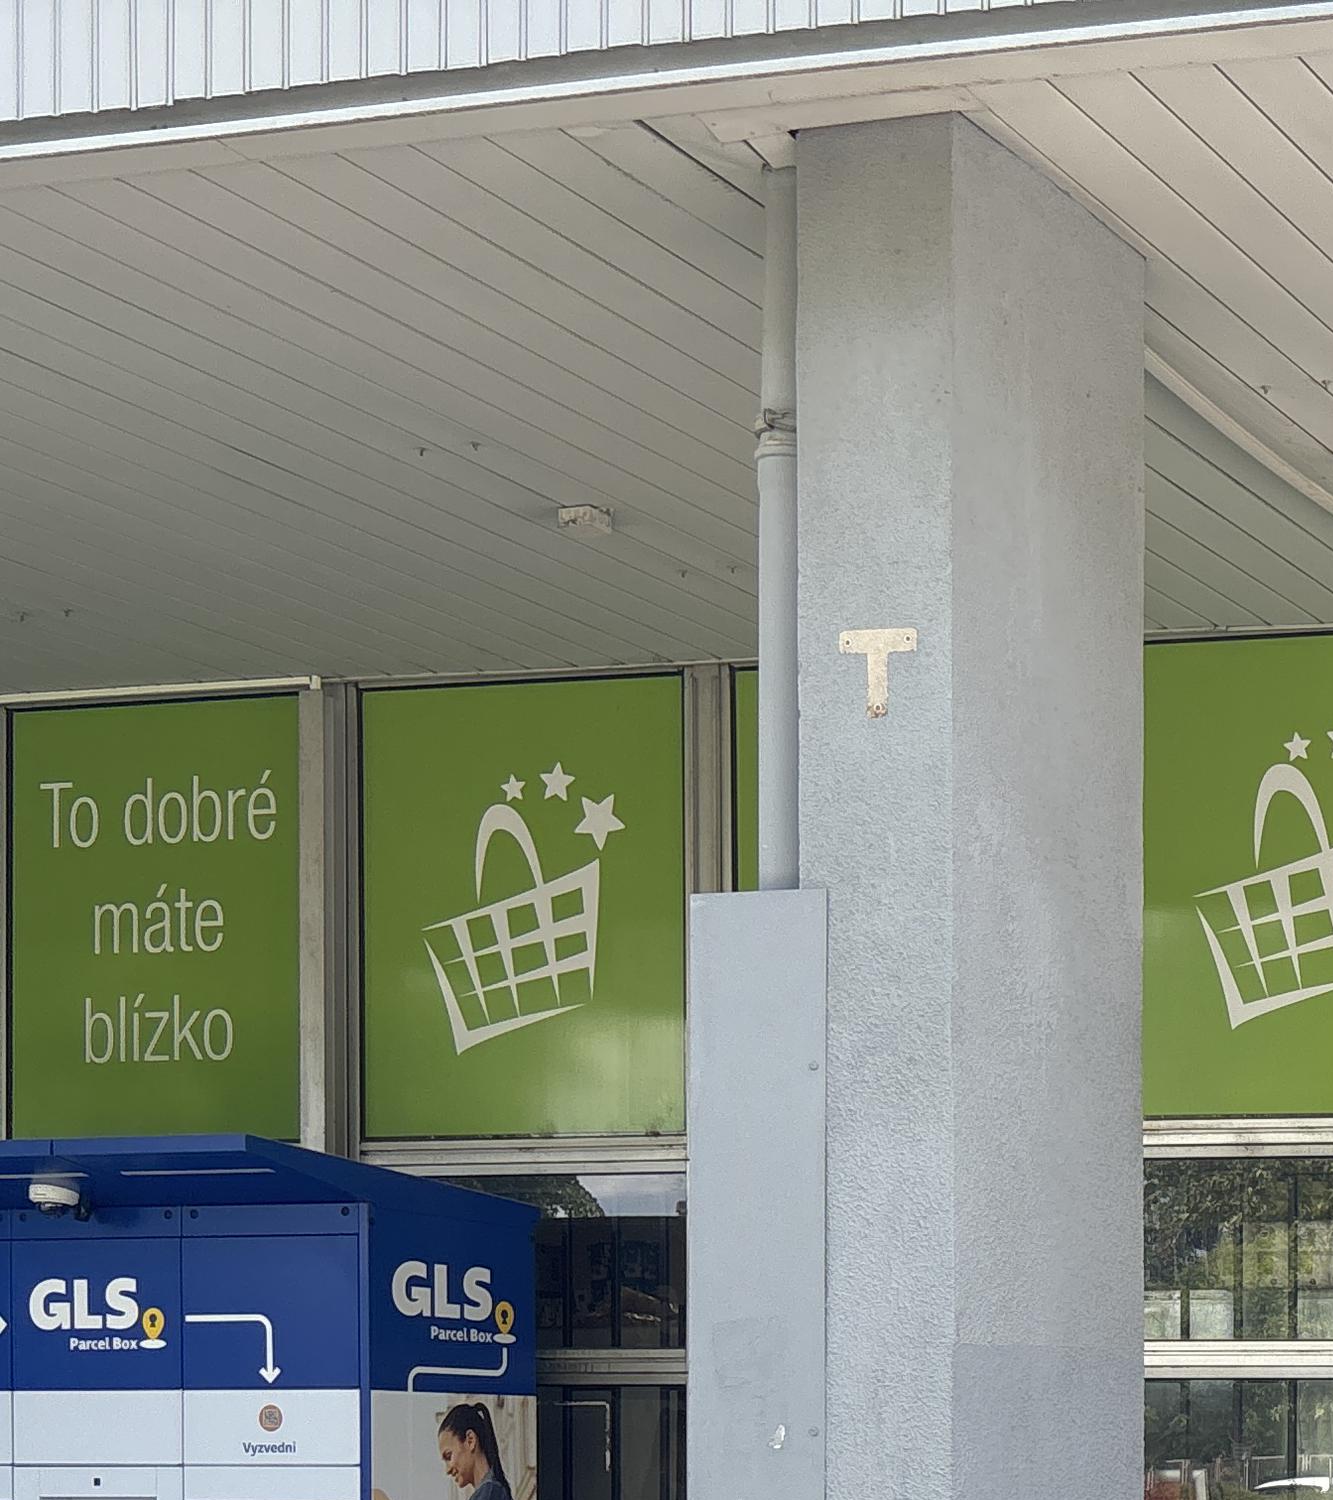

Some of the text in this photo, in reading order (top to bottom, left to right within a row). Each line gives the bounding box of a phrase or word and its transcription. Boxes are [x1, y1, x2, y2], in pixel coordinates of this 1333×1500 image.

[40, 769, 278, 848] To dobré
[94, 884, 225, 955] máte
[84, 993, 234, 1064] blízko
[29, 1277, 139, 1331] GLS
[391, 1260, 493, 1322] GLS
[70, 1336, 138, 1351] Parcel Box
[430, 1325, 493, 1343] Parcel Box
[242, 1441, 297, 1455] Vyzvedni
